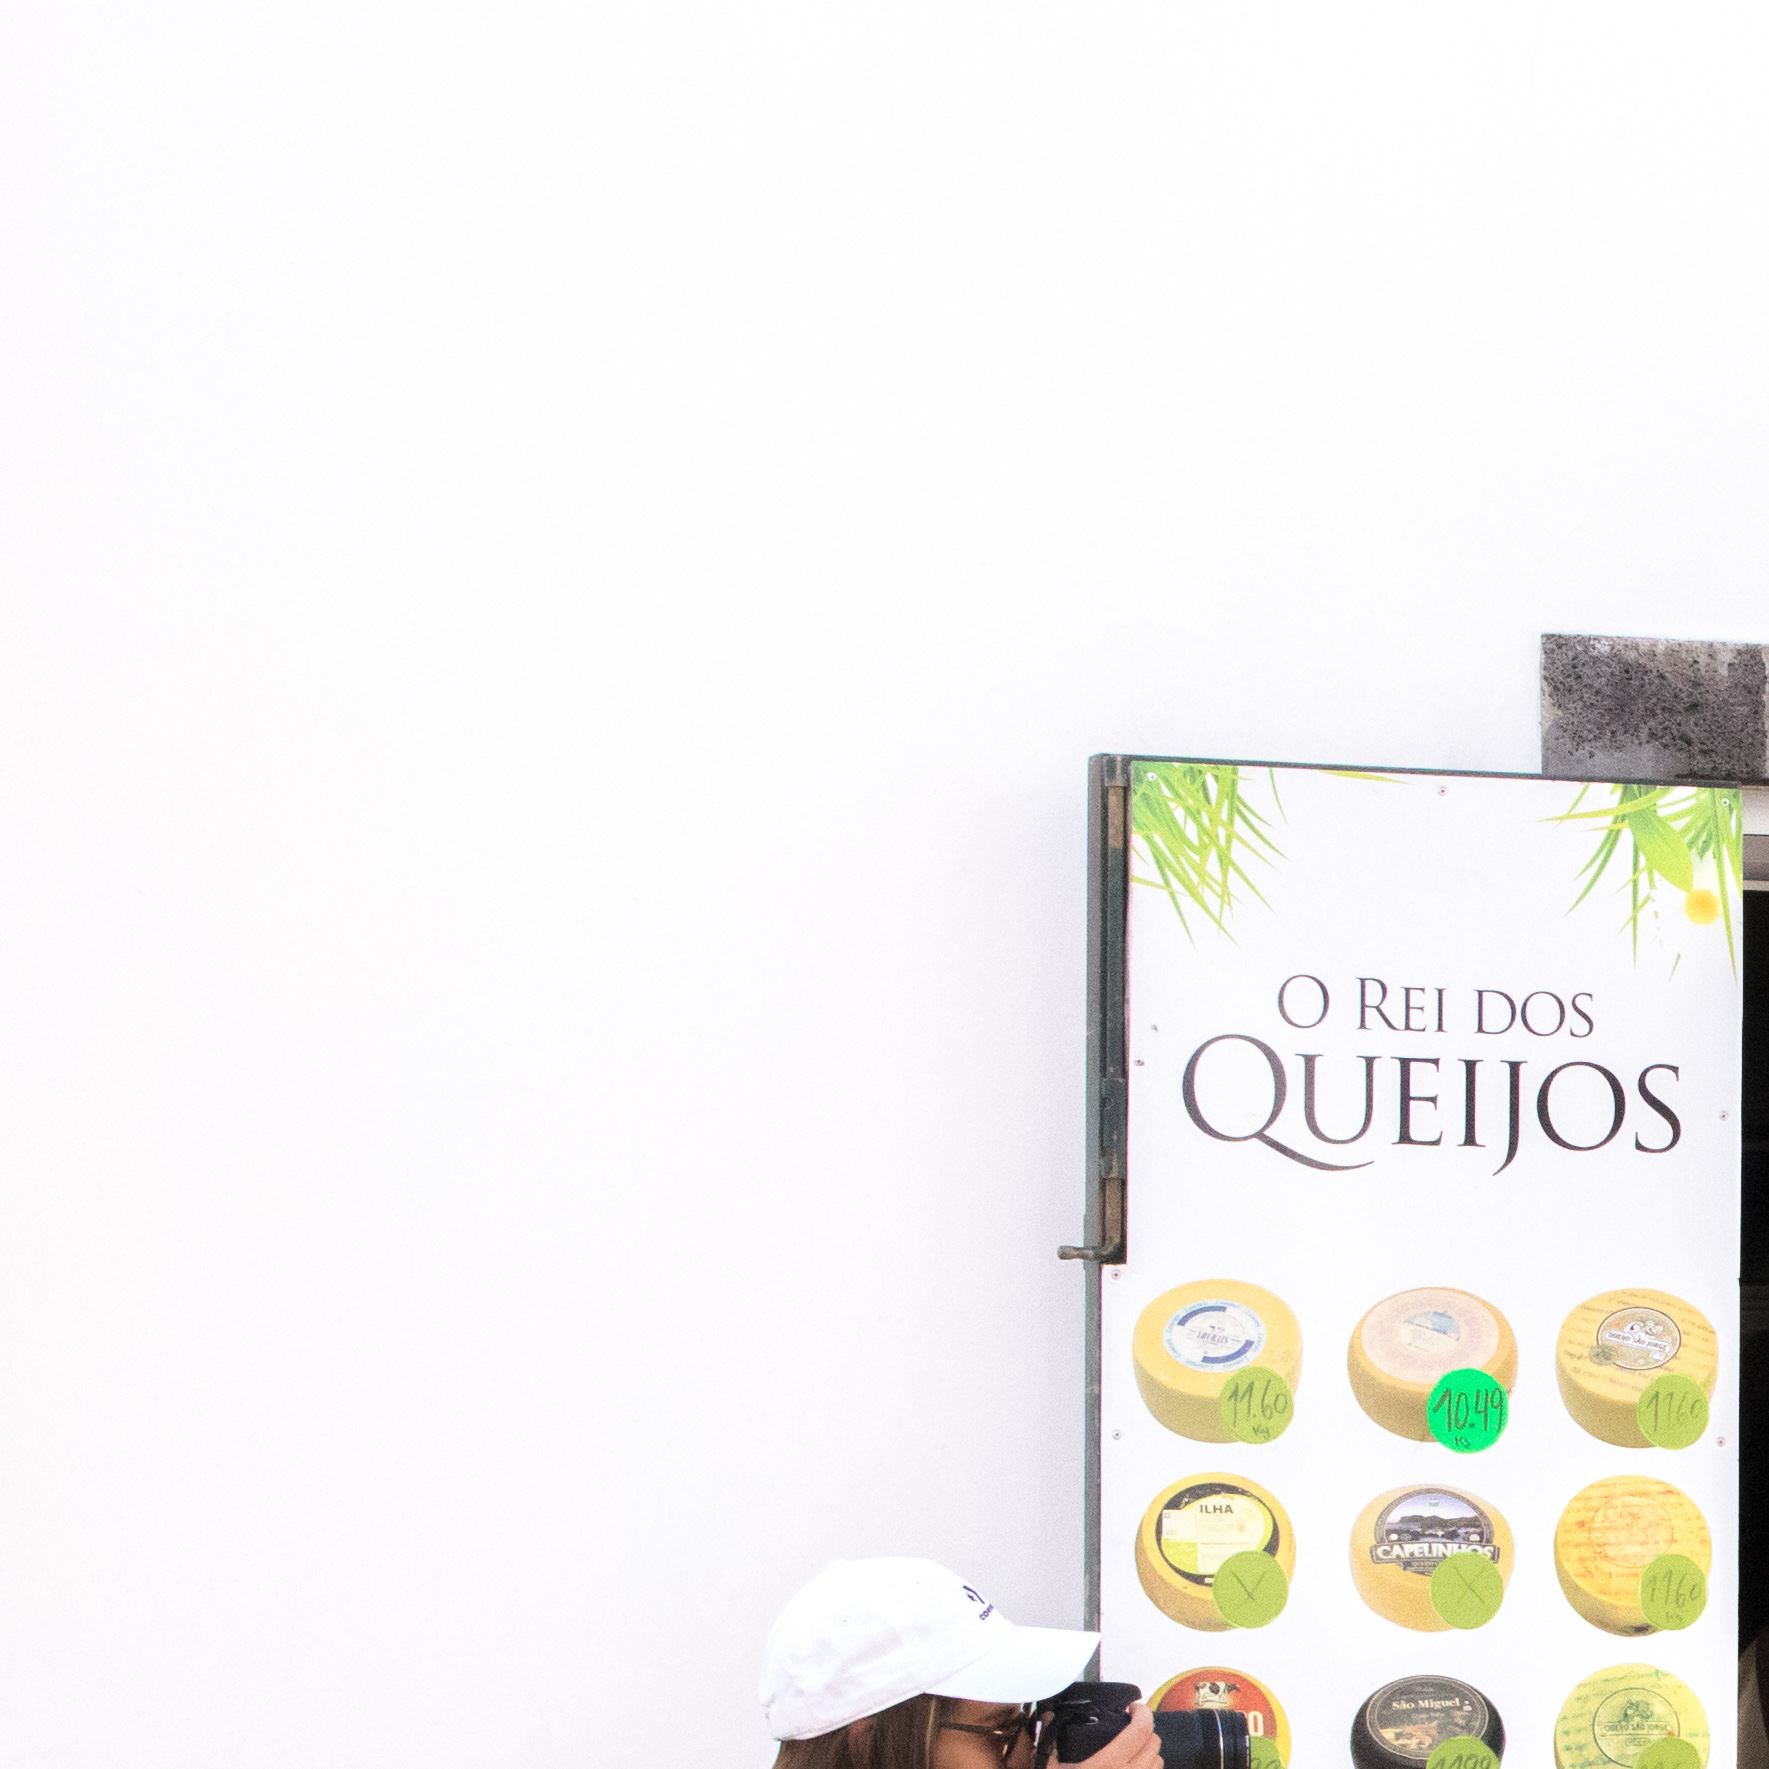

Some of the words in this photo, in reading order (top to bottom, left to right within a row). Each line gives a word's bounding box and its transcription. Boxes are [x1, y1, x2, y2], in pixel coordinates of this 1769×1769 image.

[1277, 974, 1329, 1029] O
[1354, 977, 1448, 1033] REI
[1473, 989, 1595, 1037] DOS
[1181, 1034, 1682, 1176] QUEIJOS
[1433, 1388, 1503, 1432] 10.49
[1199, 1504, 1233, 1514] ILHA
[1392, 1700, 1415, 1710] São
[1417, 1698, 1460, 1710] Miguel
